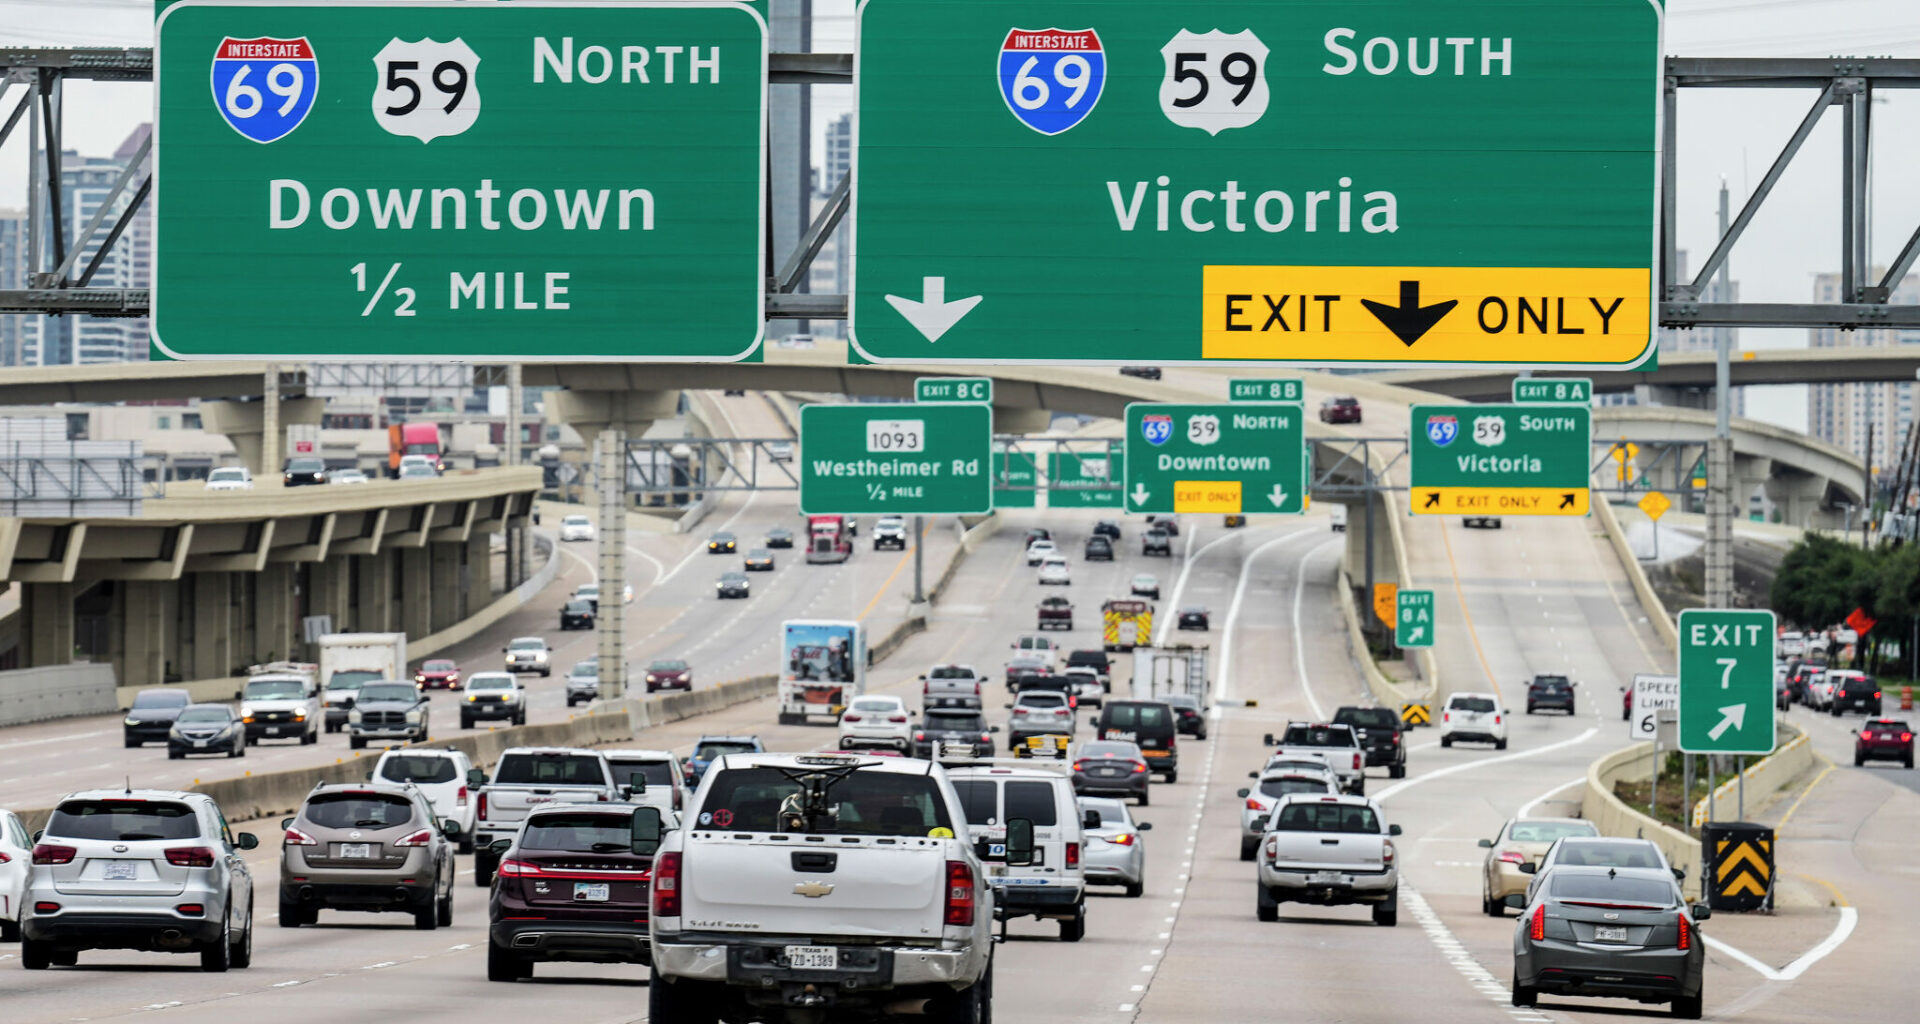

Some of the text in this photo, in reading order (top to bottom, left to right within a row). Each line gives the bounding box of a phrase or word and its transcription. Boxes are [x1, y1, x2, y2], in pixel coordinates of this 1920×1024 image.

[227, 43, 301, 57] INTERSTATE
[1015, 34, 1088, 49] INTERSTATE
[533, 36, 720, 84] NORTH
[1322, 27, 1512, 76] SOUTH
[385, 60, 468, 116] 59
[1012, 54, 1092, 110] 69
[1172, 52, 1257, 108] 59
[225, 63, 304, 118] 69
[269, 178, 655, 231] Downtown
[1106, 175, 1400, 234] Victoria
[450, 271, 570, 310] MILE
[1225, 294, 1625, 335] EXIT ONLY
[922, 385, 950, 397] EXIT
[1235, 385, 1263, 396] EXIT
[1520, 385, 1548, 397] EXIT
[1191, 421, 1216, 438] 59
[1233, 414, 1289, 429] NORTH
[1520, 415, 1575, 431] SOUTH
[1145, 422, 1170, 439] 69
[1429, 422, 1455, 440] 69
[1476, 422, 1501, 439] 59
[873, 432, 918, 449] 1093
[813, 458, 941, 476] Westheimer
[952, 458, 979, 476] Rd
[1158, 454, 1271, 471] Downtown
[1457, 454, 1542, 473] Victoria
[893, 486, 923, 498] MILE
[1177, 491, 1239, 503] EXIT ONLY
[1456, 496, 1541, 508] EXIT ONLY
[1400, 594, 1429, 605] EXIT
[1691, 624, 1763, 646] EXIT
[1716, 658, 1737, 689] 7
[1641, 698, 1674, 709] LIMIT
